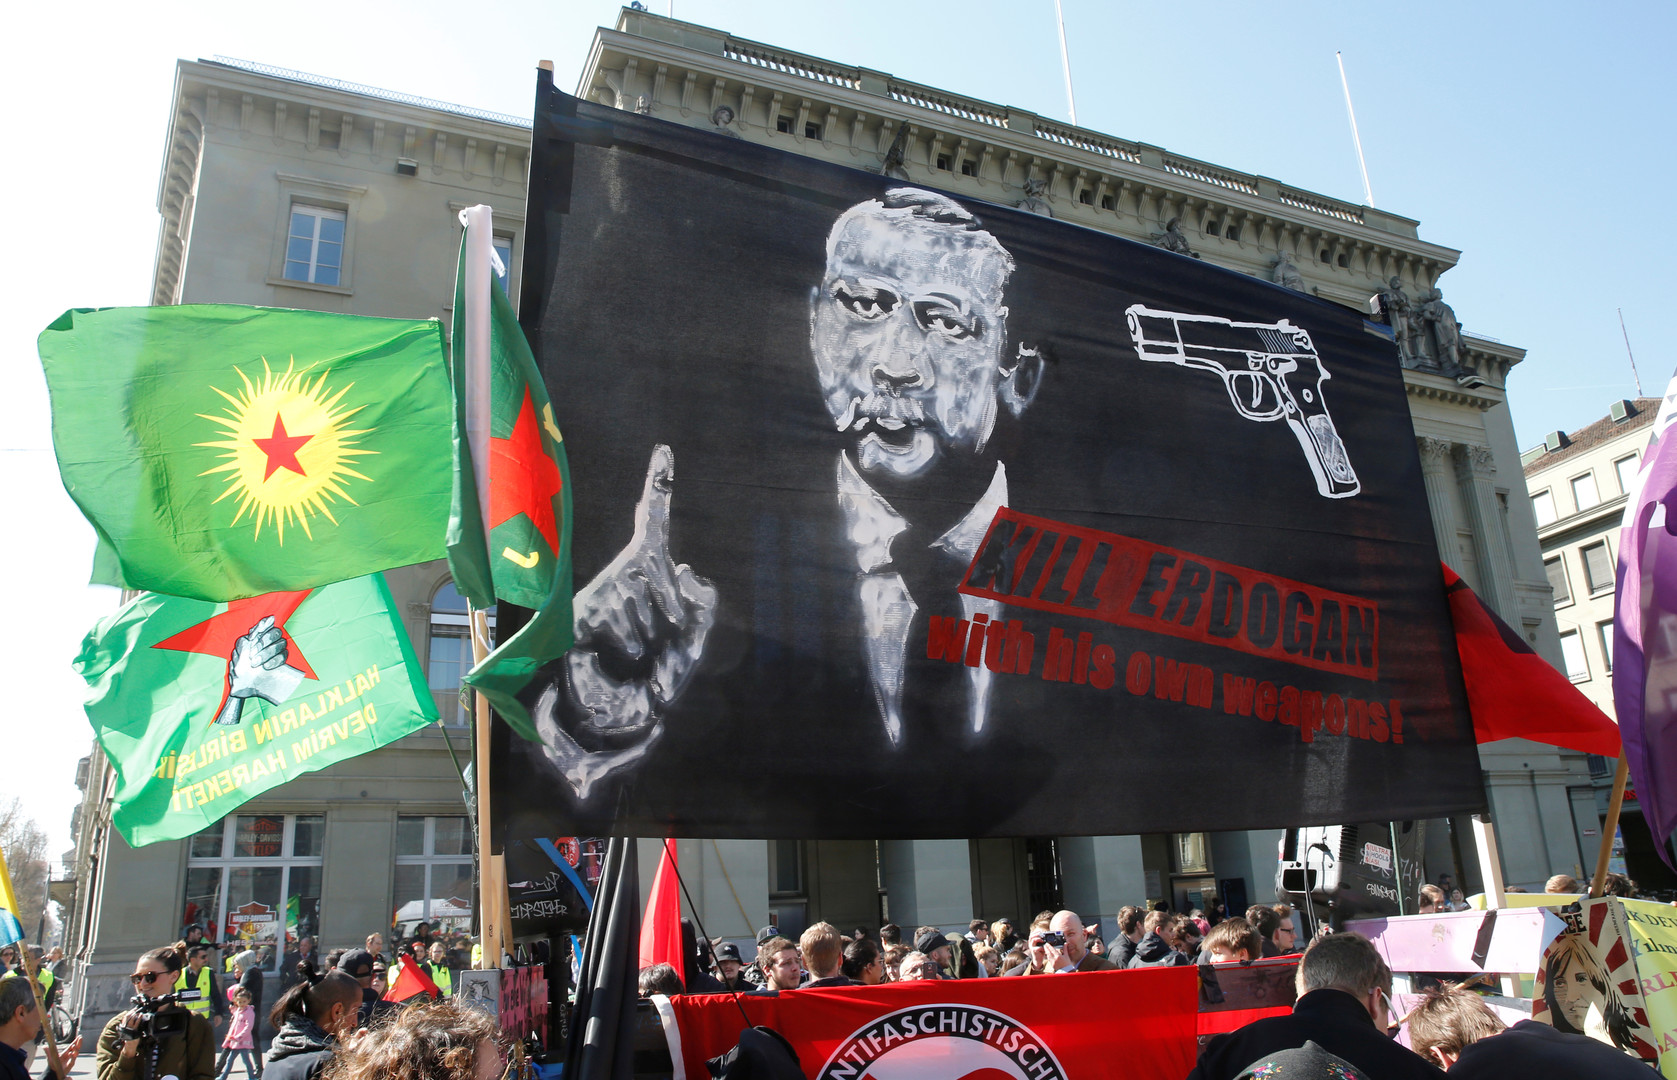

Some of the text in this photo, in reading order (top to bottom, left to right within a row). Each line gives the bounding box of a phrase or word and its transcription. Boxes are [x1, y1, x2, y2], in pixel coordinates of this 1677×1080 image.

[967, 519, 1374, 668] KILL ERDOGAN
[926, 613, 1404, 744] with his own weapons!
[1622, 789, 1638, 801] BS
[829, 1011, 1059, 1080] NTIFASCHISTISCH
